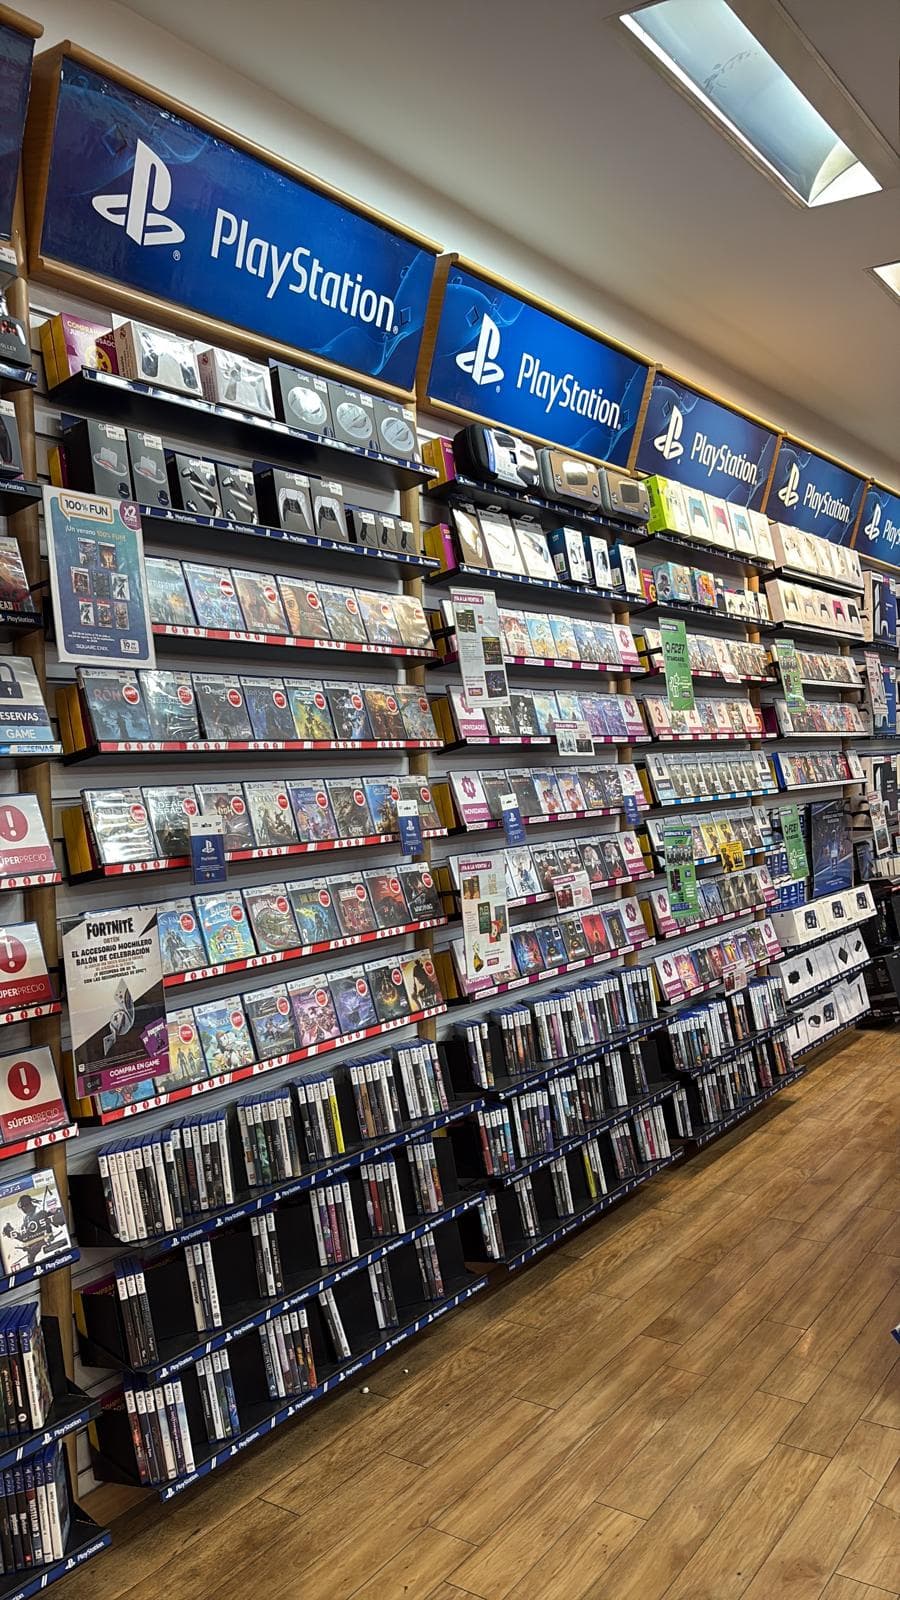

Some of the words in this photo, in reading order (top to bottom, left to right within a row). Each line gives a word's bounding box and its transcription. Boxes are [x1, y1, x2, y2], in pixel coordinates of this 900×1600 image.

[210, 207, 395, 333] PlayStation
[516, 352, 619, 430] PlayStation
[690, 432, 757, 485] PlayStation
[64, 499, 88, 512] 100%
[89, 504, 108, 516] FUN
[803, 483, 850, 524] PlayStation
[7, 615, 35, 623] PlayStation
[0, 711, 39, 722] ESERVAS
[6, 729, 37, 739] GAME
[86, 917, 134, 940] FORTNITE
[76, 956, 98, 966] BALÓN
[109, 947, 151, 960] CELEBRACIÓN
[81, 944, 117, 956] ACCESORIO
[118, 938, 153, 951] MOCHILERO
[109, 1064, 136, 1078] COMPRA
[136, 1063, 145, 1071] EN
[144, 1058, 161, 1068] GAME
[224, 1210, 246, 1222] PlayStation
[10, 1215, 55, 1239] GHOST
[181, 1229, 203, 1242] PlayStation
[45, 1254, 73, 1271] PlayStation
[169, 1356, 194, 1372] PlayStation
[53, 1418, 82, 1437] PlayStation
[175, 1473, 200, 1492] PlayStation
[76, 1540, 105, 1562] PlayStation
